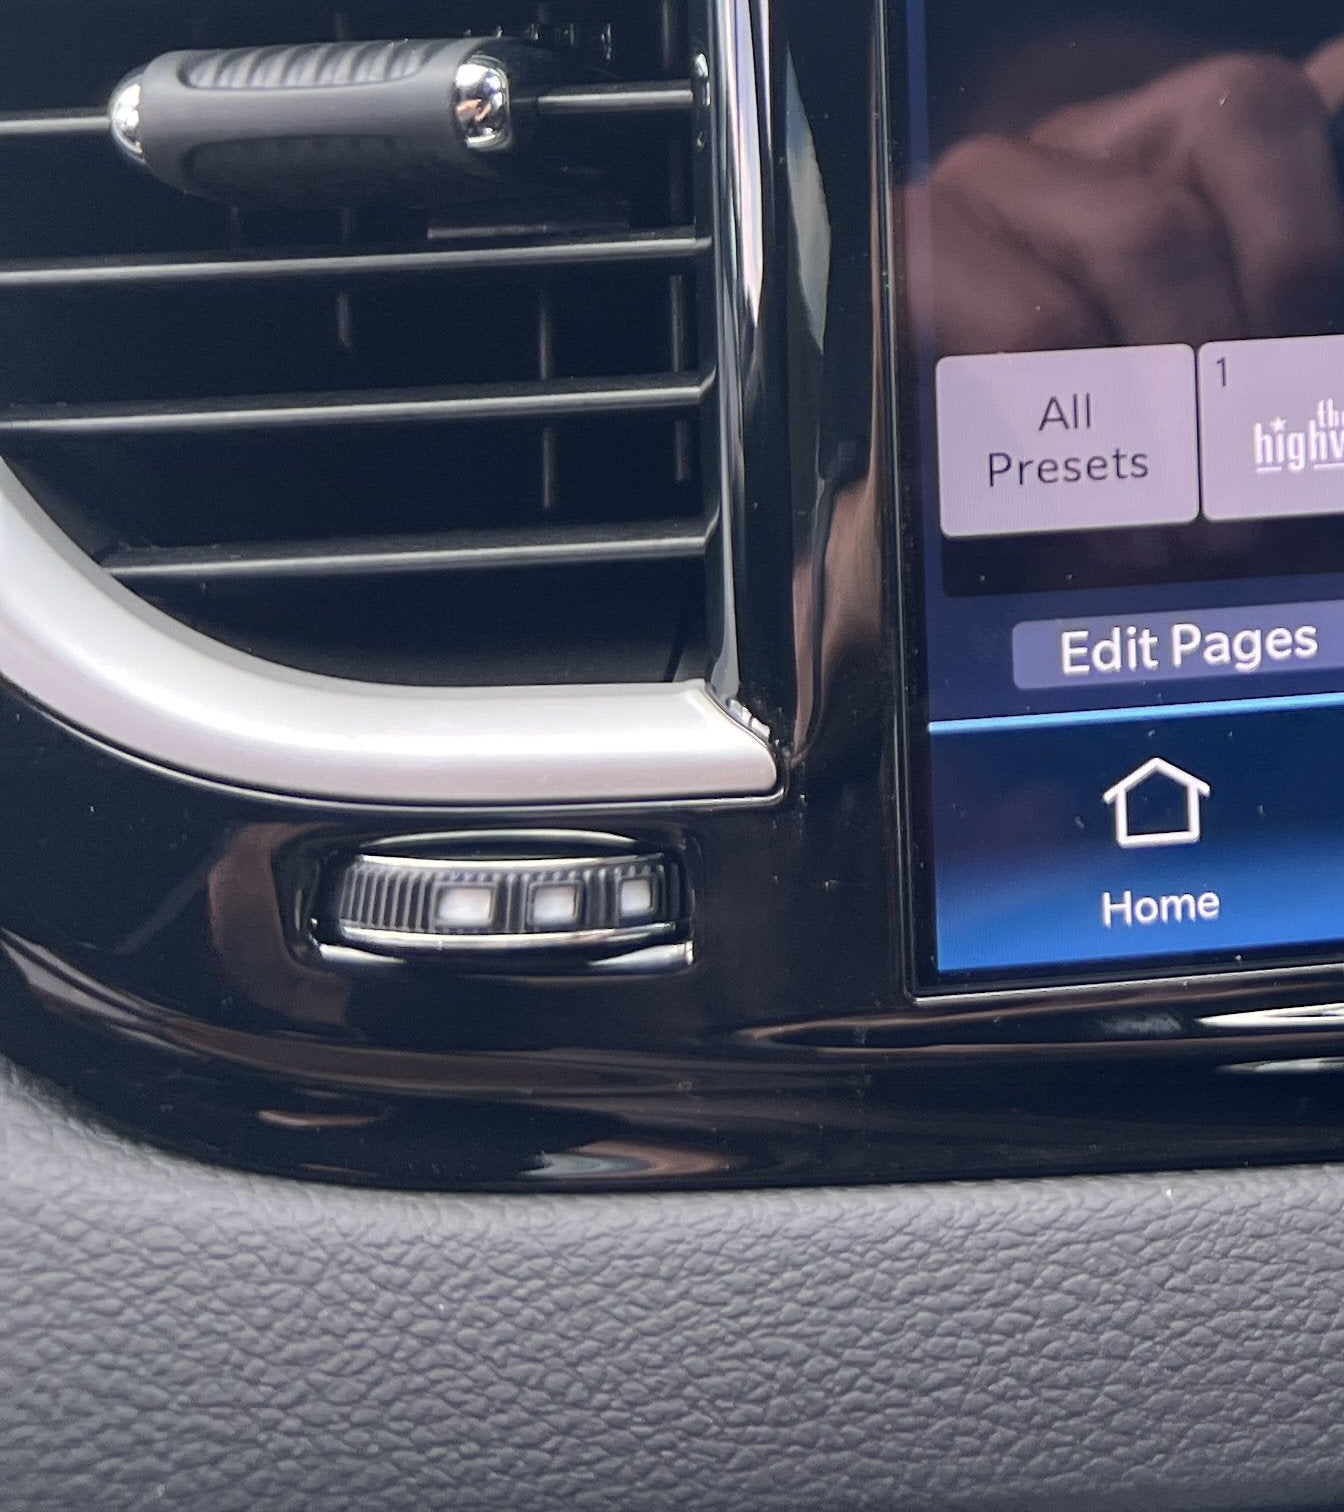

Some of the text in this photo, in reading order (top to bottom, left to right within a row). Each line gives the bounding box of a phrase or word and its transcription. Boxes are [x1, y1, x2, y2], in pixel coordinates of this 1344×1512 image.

[1216, 357, 1227, 387] 1
[1038, 393, 1092, 431] All
[988, 448, 1148, 488] Presets
[1061, 623, 1318, 675] Edit Pages
[1102, 890, 1220, 927] Home
